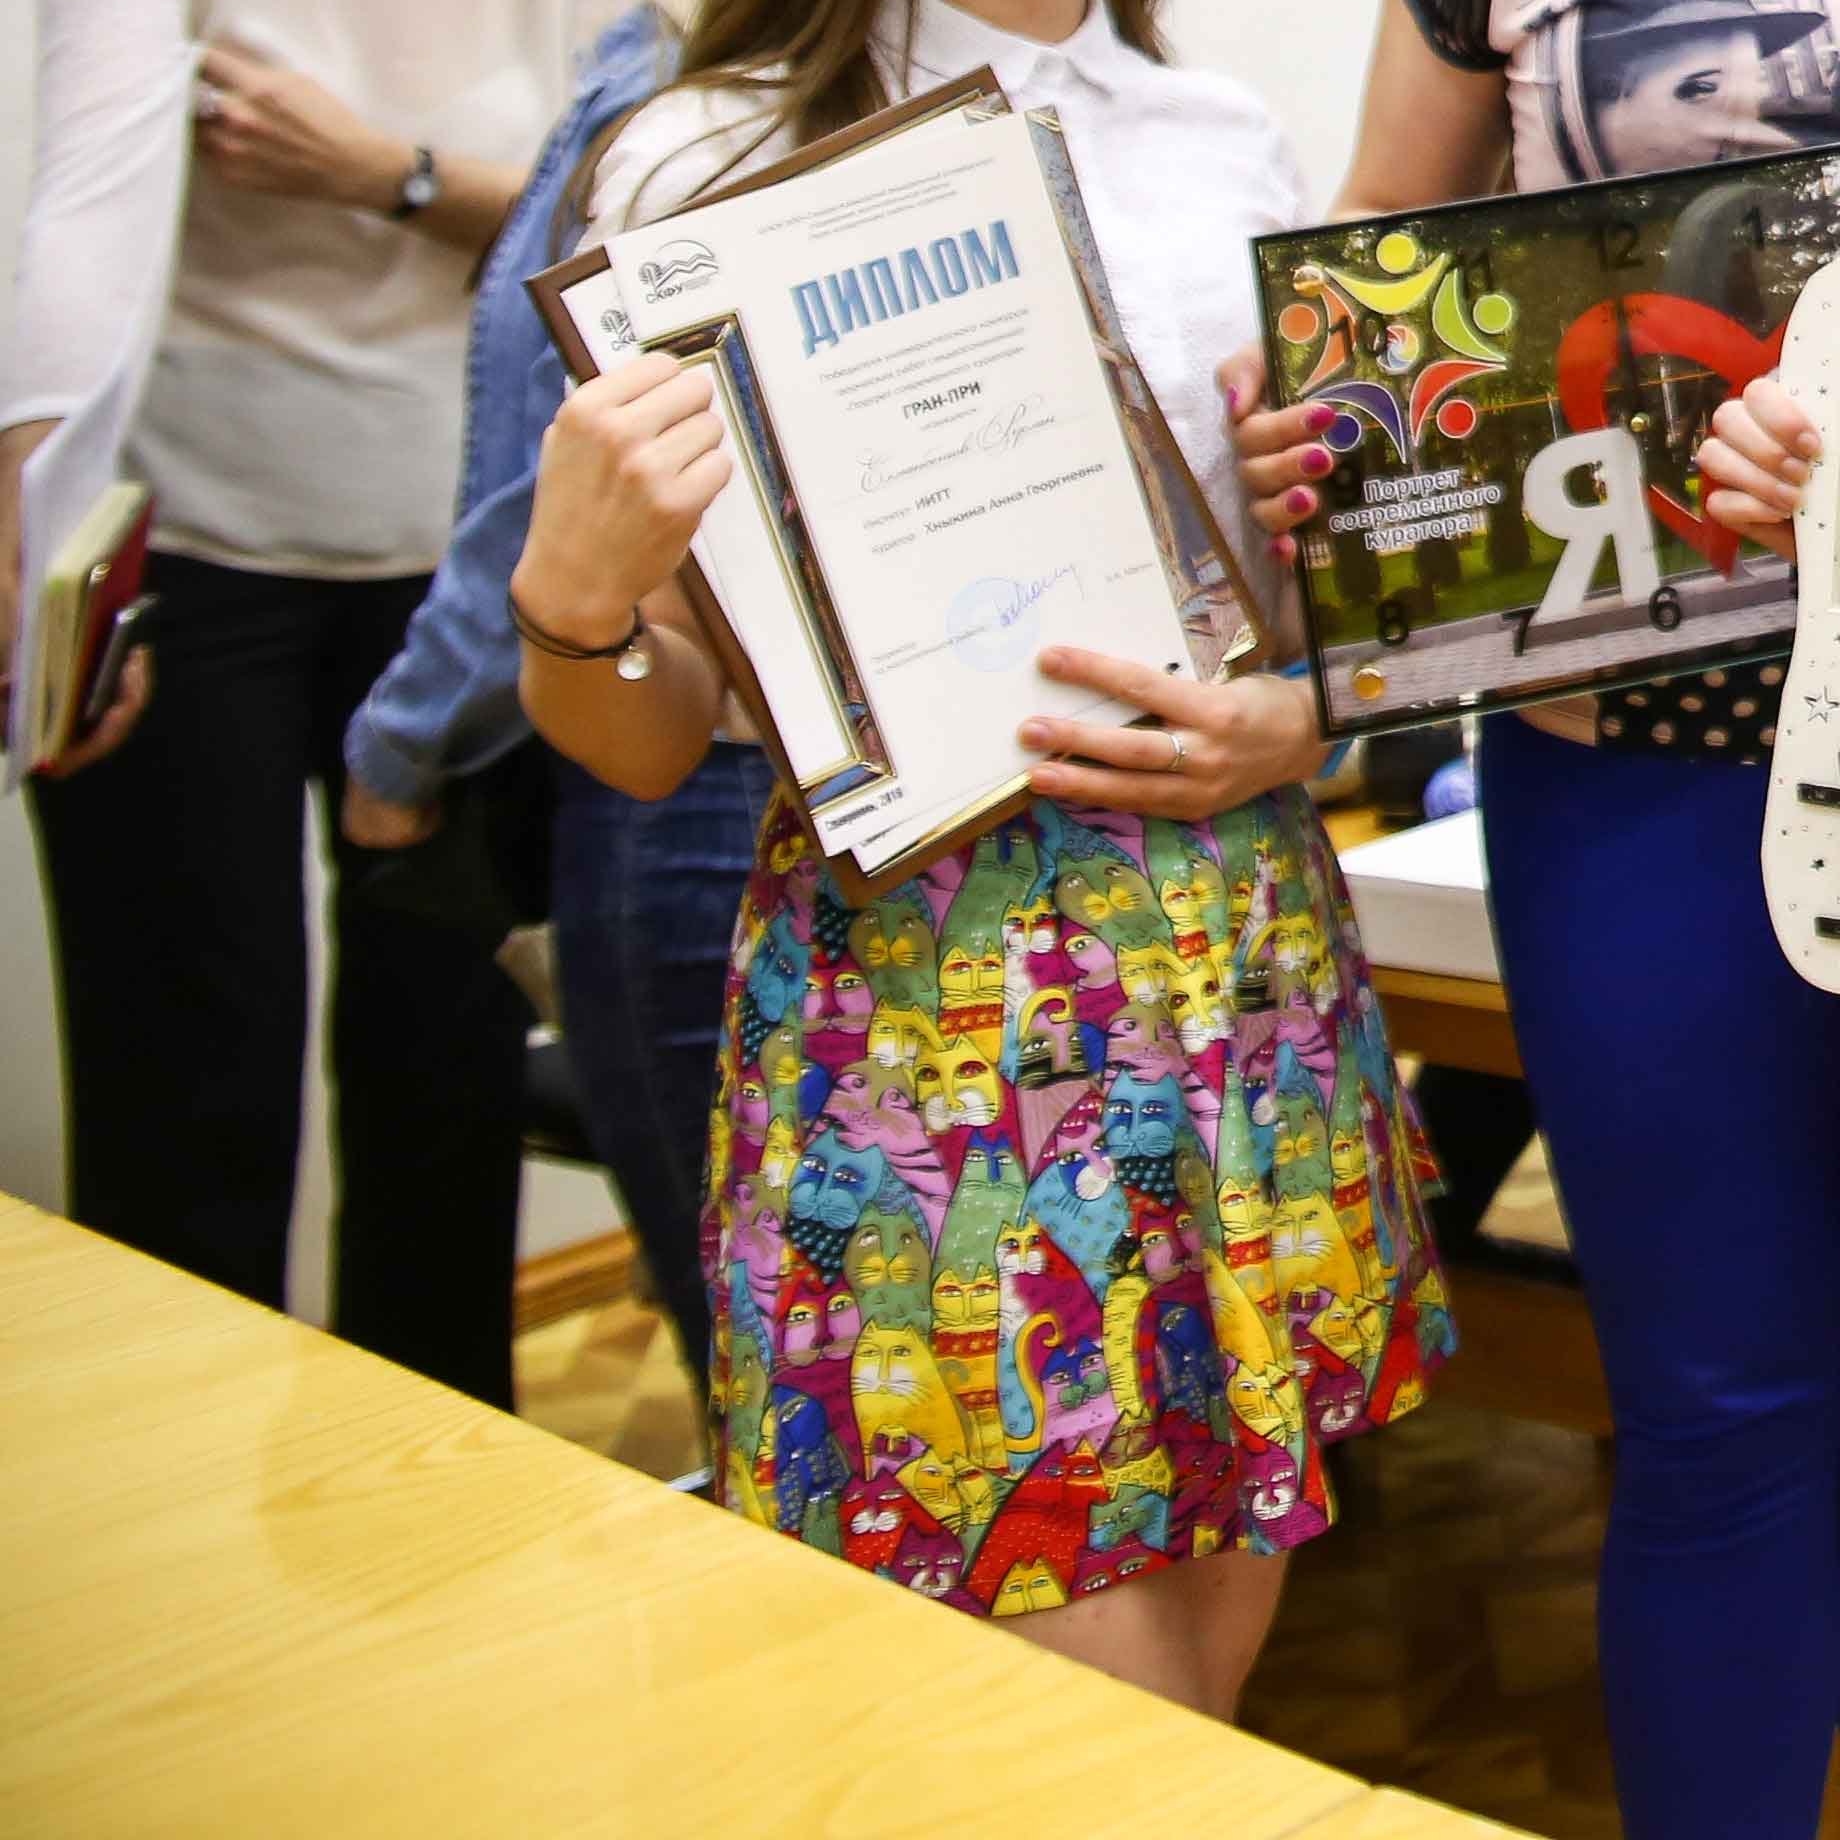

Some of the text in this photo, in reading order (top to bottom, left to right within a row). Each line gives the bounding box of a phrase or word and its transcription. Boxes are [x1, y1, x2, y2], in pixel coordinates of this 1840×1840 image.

[789, 219, 1019, 359] ДИПЛОМ
[902, 381, 981, 419] ГРАН-ПРИ
[915, 488, 951, 510] ИИТТ
[989, 491, 1025, 511] Анна
[1026, 462, 1104, 496] Георгиевна
[1329, 485, 1501, 533] современного
[1364, 470, 1460, 503] Портрет
[1365, 514, 1473, 550] куратора
[1522, 426, 1662, 625] Я
[1650, 586, 1682, 631] 6
